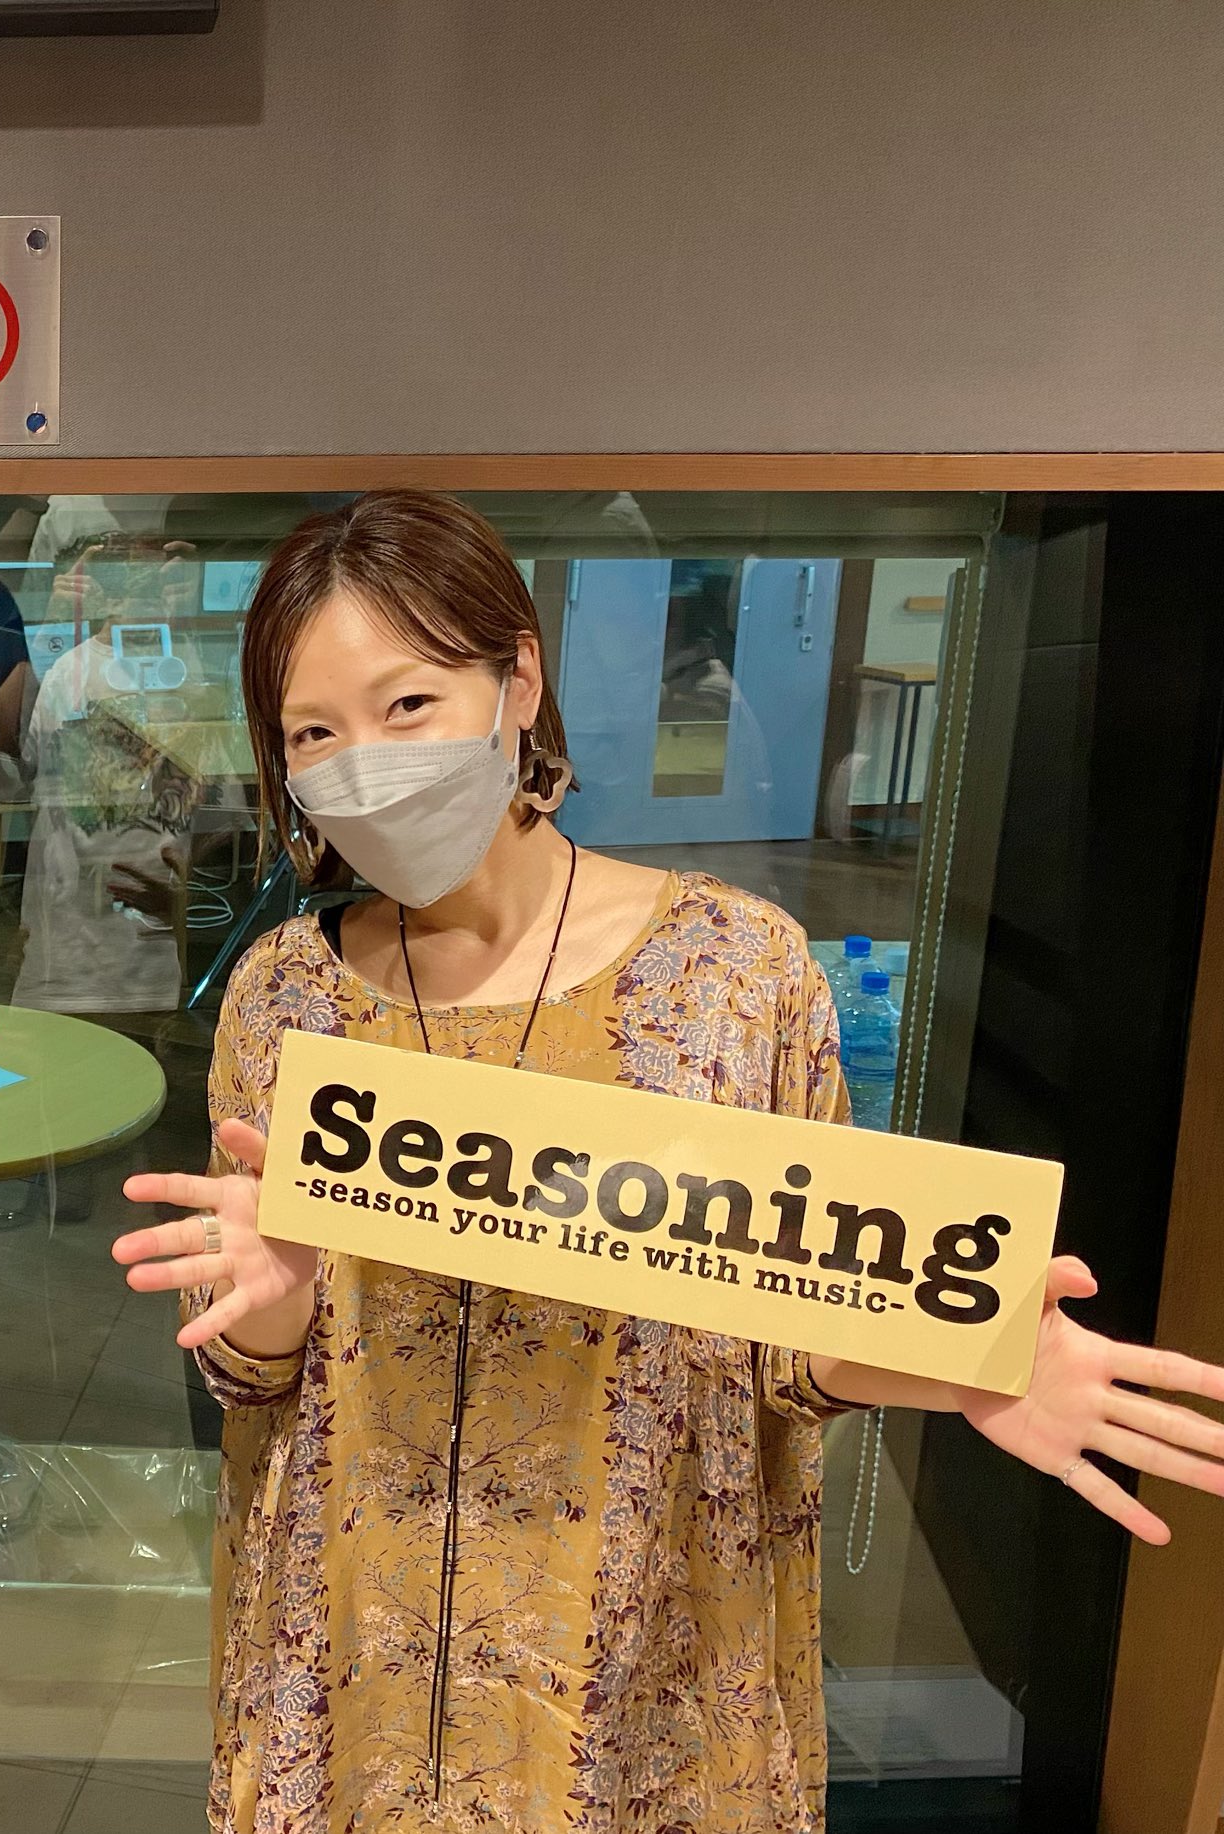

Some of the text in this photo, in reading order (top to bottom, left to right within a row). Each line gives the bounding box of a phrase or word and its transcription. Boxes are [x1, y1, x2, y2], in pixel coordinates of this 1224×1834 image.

[294, 1178, 906, 1316] -season your life with music-
[300, 1083, 1013, 1326] Seasoning
